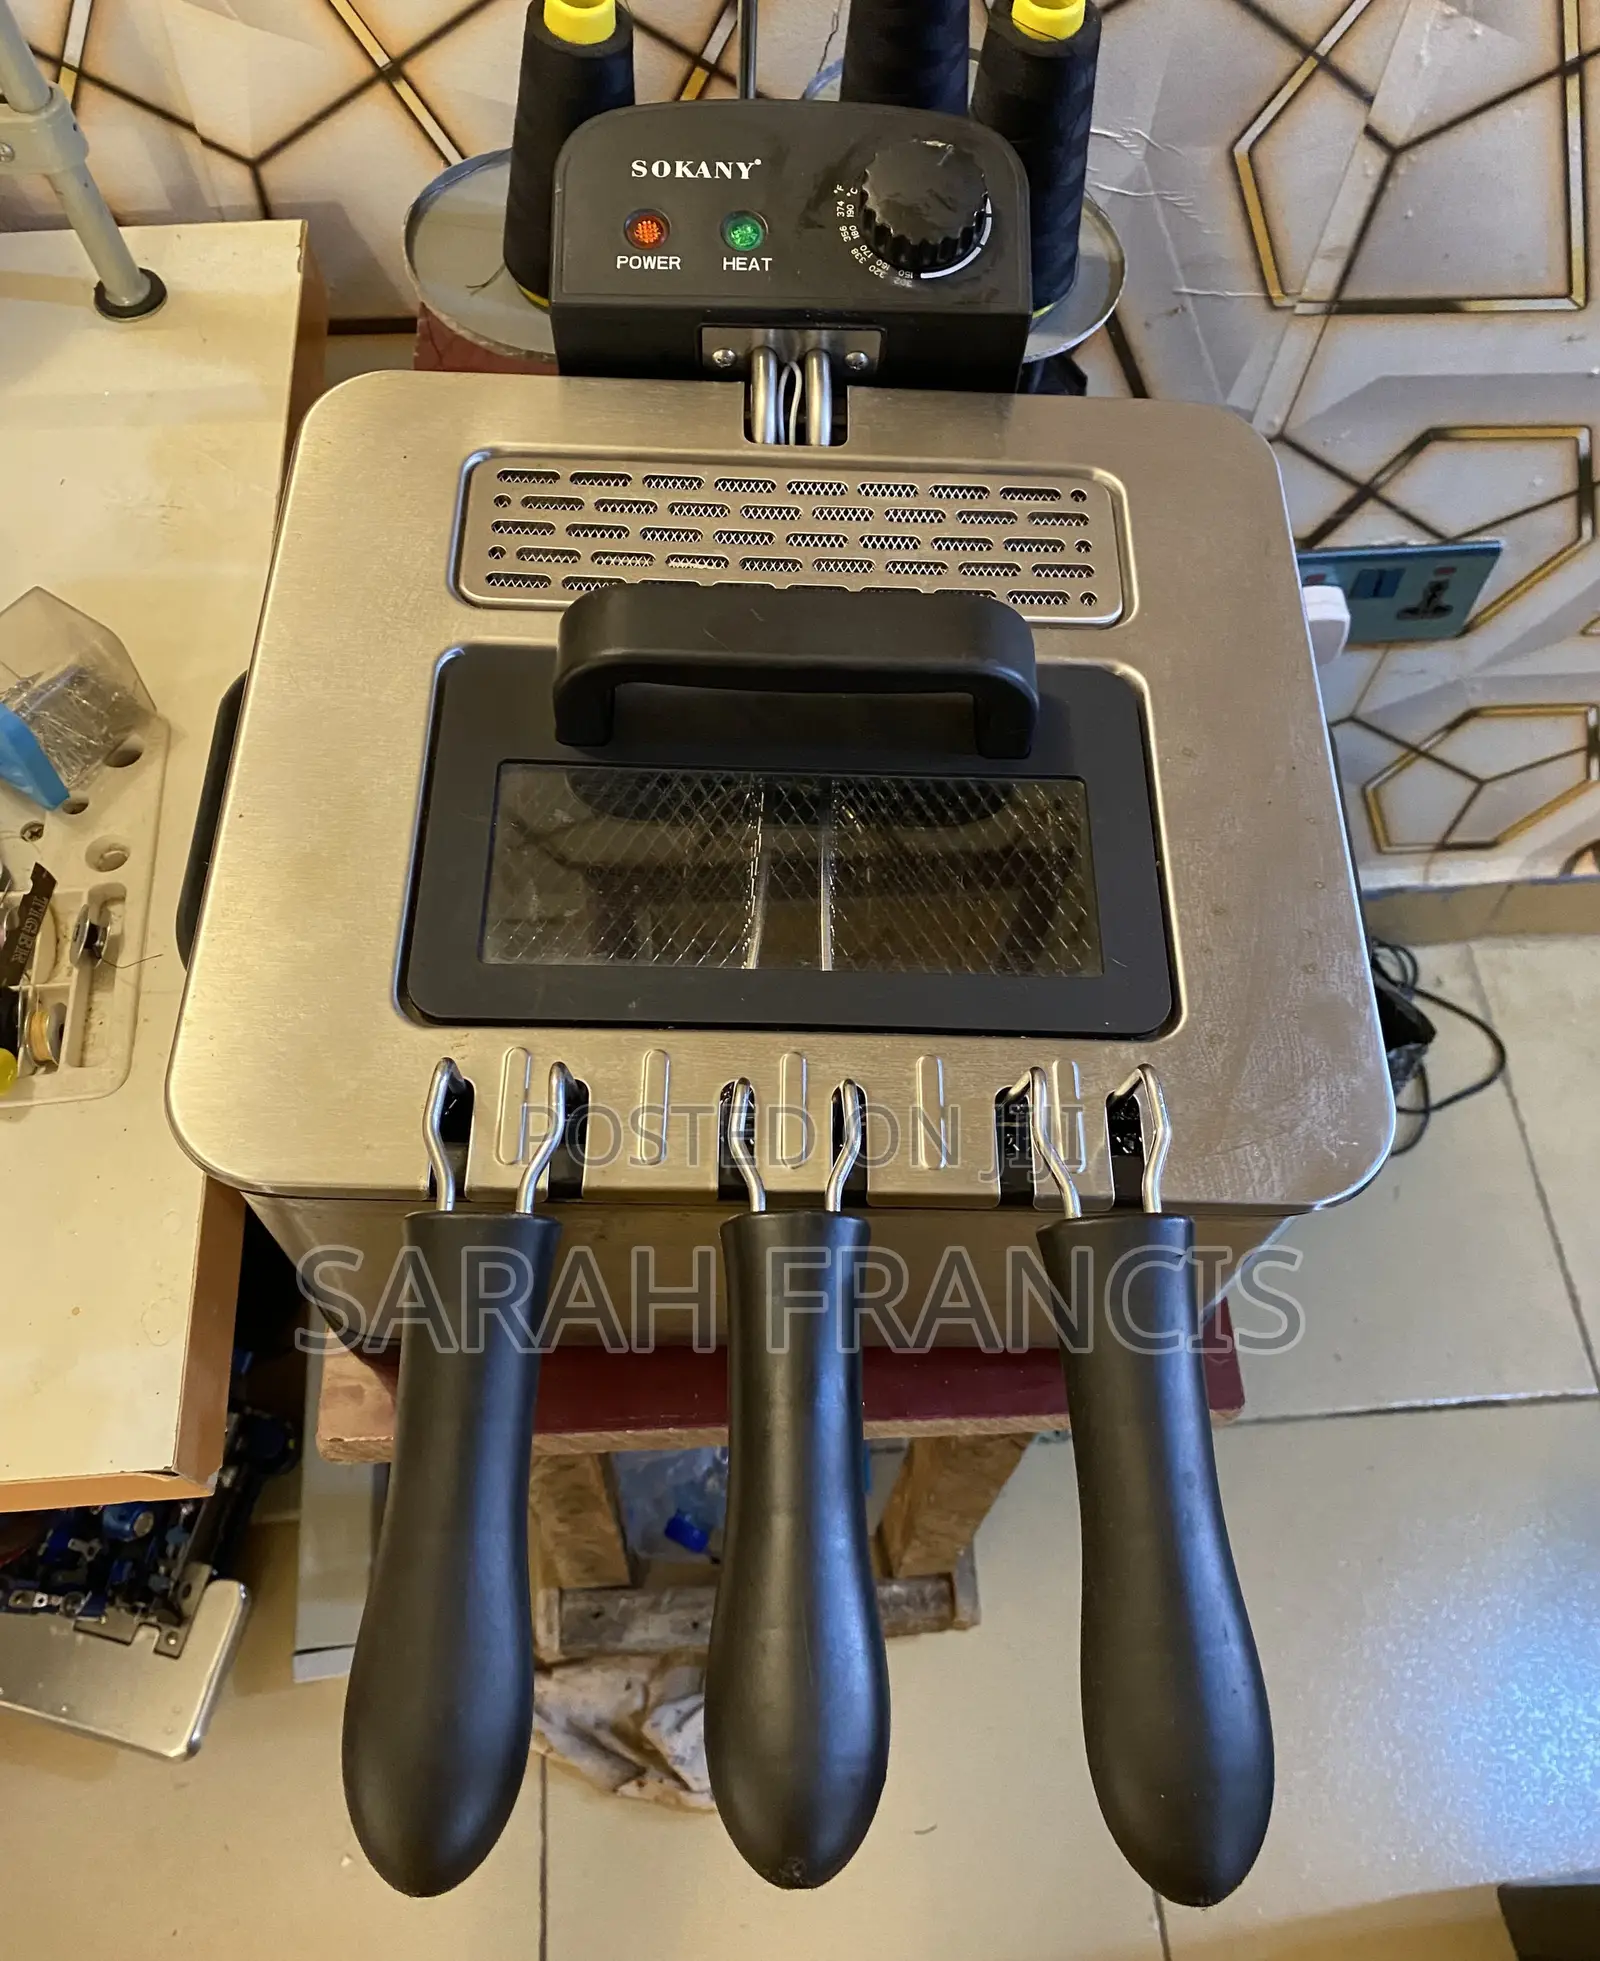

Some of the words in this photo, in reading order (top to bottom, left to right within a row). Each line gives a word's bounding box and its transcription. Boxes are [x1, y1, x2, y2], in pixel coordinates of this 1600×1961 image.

[631, 158, 762, 180] SOKANY
[836, 200, 845, 217] 374
[846, 204, 855, 218] 190
[839, 225, 852, 243] 356
[848, 225, 860, 239] 180
[850, 247, 867, 264] 338
[859, 244, 874, 259] 170
[616, 255, 682, 270] POWER
[722, 256, 773, 272] HEAT
[875, 258, 891, 271] 160
[868, 264, 888, 279] 320
[898, 269, 914, 279] 150
